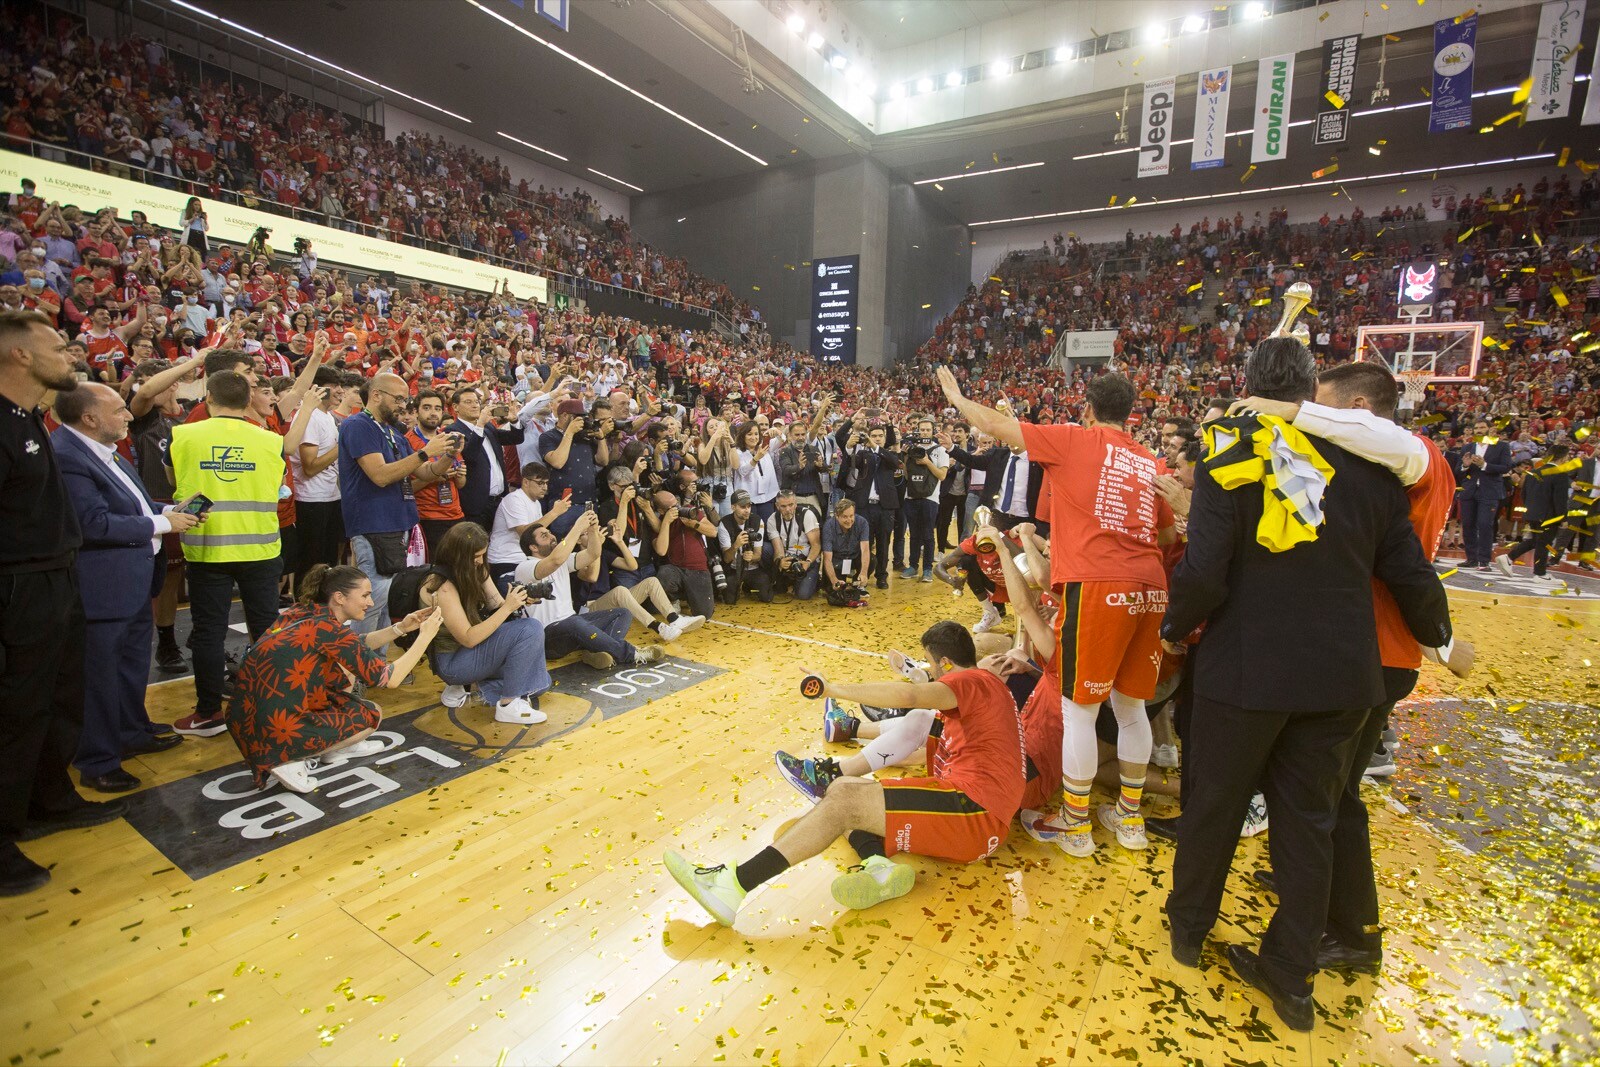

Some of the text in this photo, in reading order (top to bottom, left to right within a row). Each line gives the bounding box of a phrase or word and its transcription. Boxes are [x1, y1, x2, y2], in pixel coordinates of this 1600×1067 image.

[1328, 39, 1343, 91] DE VERDAD
[1338, 36, 1358, 102] BURGERS
[1145, 79, 1175, 89] MotorDOS
[1141, 92, 1173, 162] Jeep
[1204, 96, 1218, 158] MANZANO
[1139, 164, 1168, 173] MotorDOS
[1113, 460, 1153, 481] 2021-202
[1146, 590, 1169, 603] RUR
